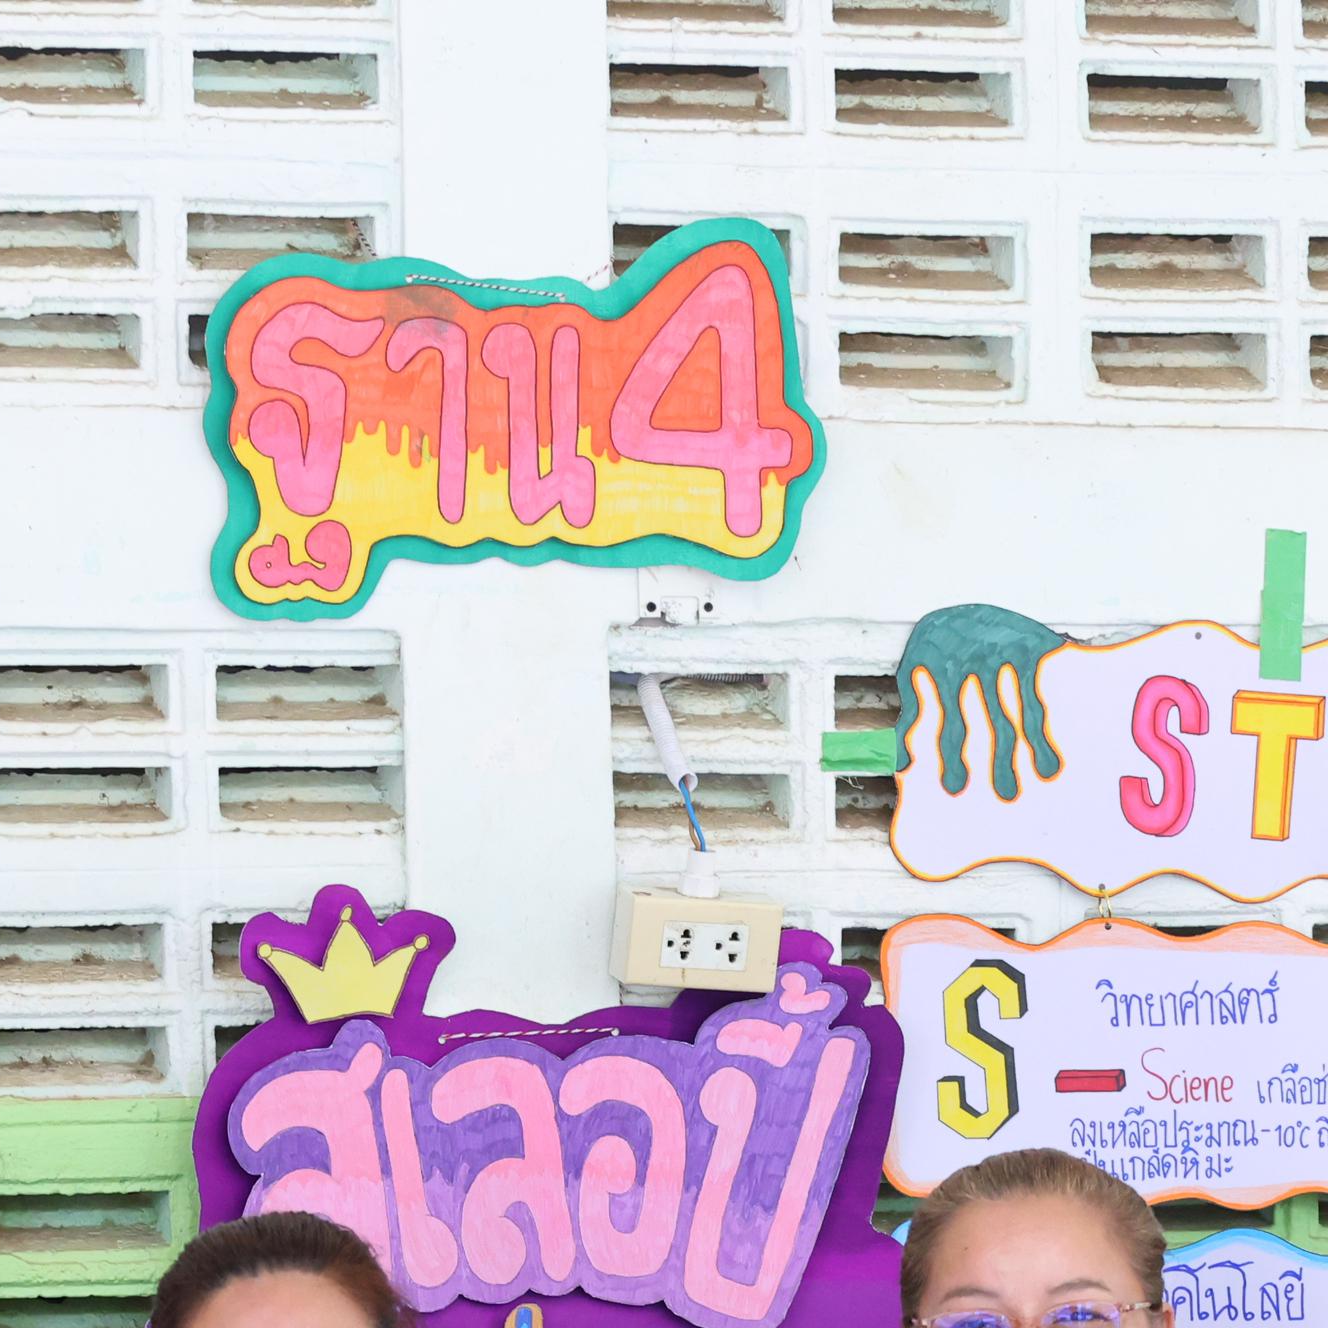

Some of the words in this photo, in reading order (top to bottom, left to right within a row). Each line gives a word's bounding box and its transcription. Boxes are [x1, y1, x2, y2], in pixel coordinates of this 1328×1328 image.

[1096, 971, 1280, 1027] วิทยาศาสตร์
[936, 958, 1029, 1139] S
[1141, 1047, 1234, 1104] Sciene
